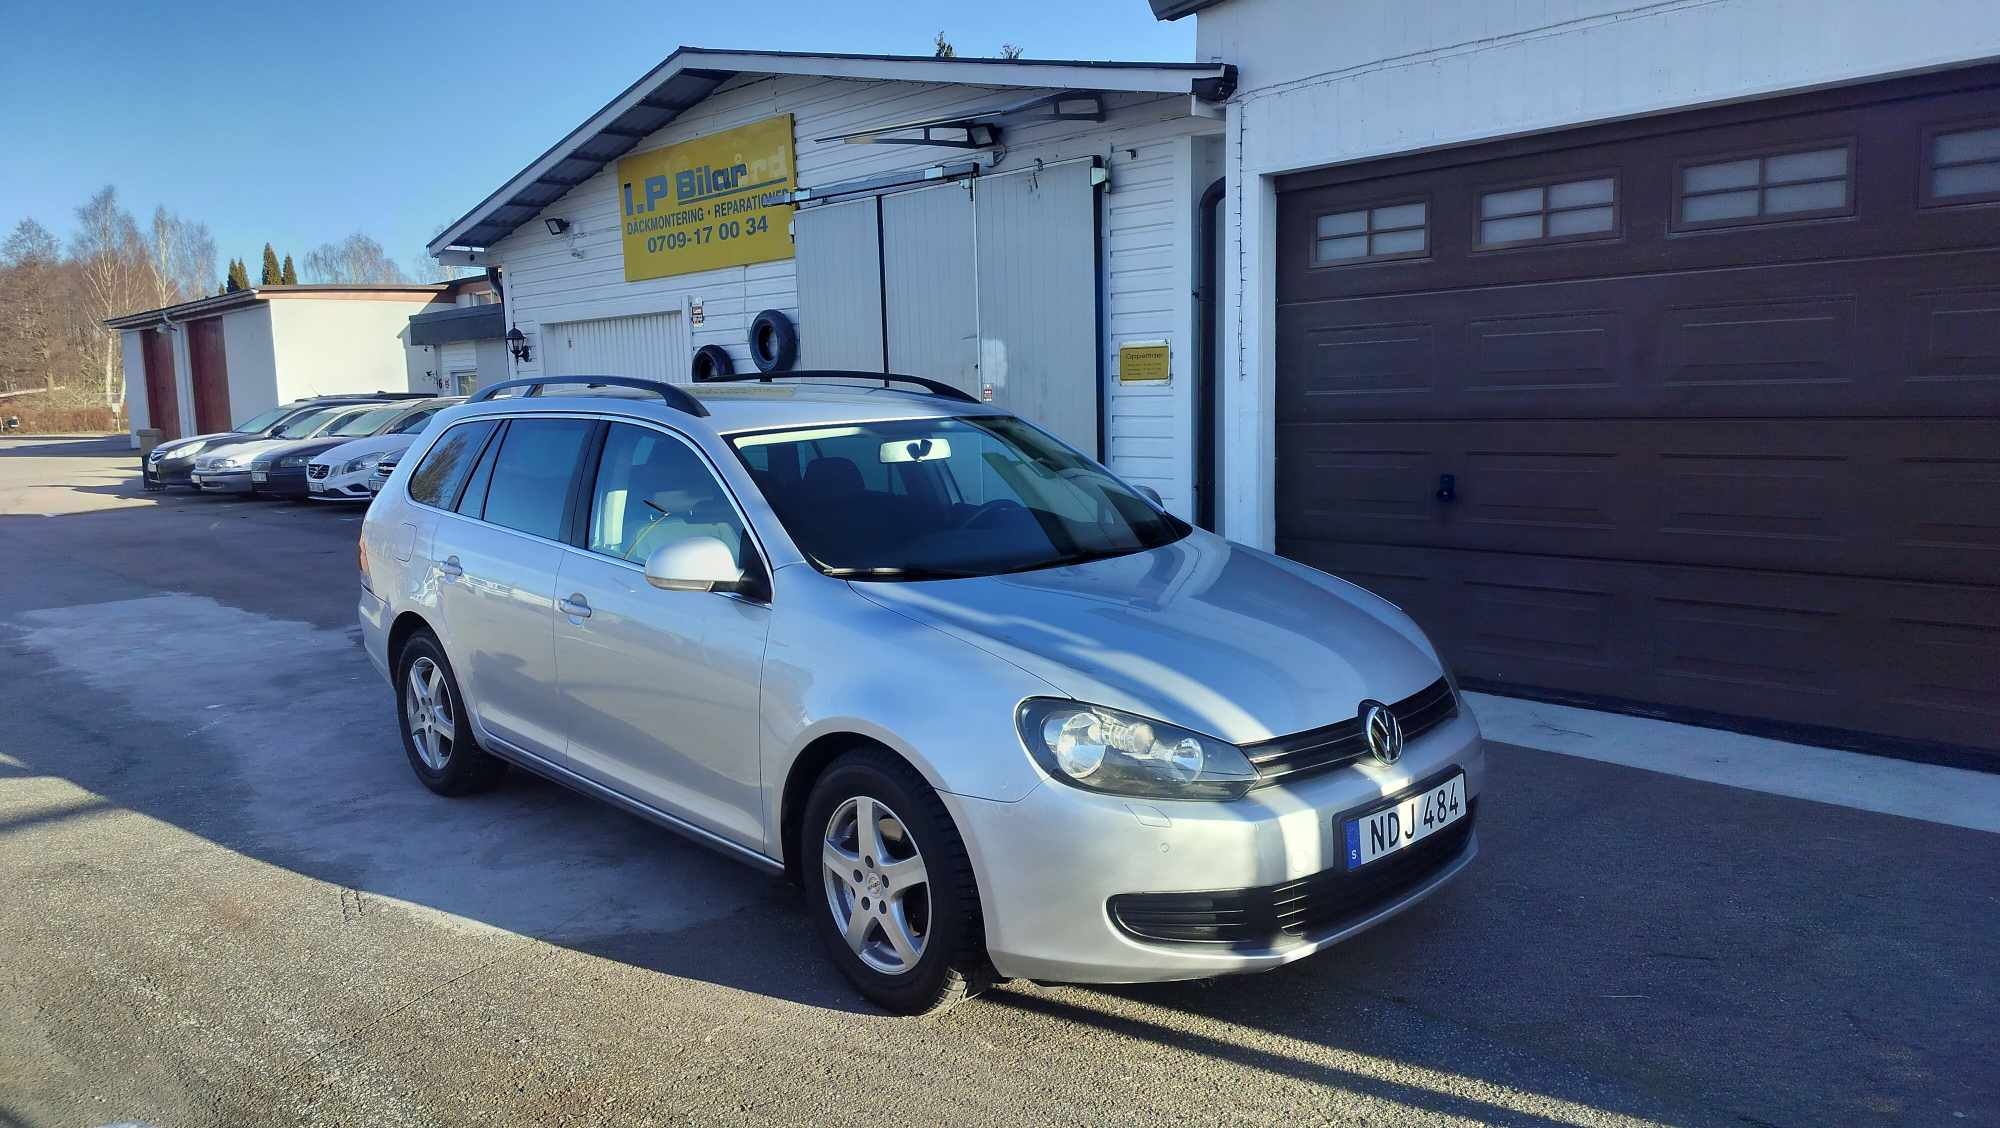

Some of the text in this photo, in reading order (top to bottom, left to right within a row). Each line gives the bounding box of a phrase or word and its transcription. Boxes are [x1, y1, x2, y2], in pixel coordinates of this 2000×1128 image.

[676, 163, 747, 200] Bilar
[648, 216, 768, 253] 0709-17 00 34
[1370, 783, 1458, 855] NDJ 484
[1351, 850, 1357, 860] S
